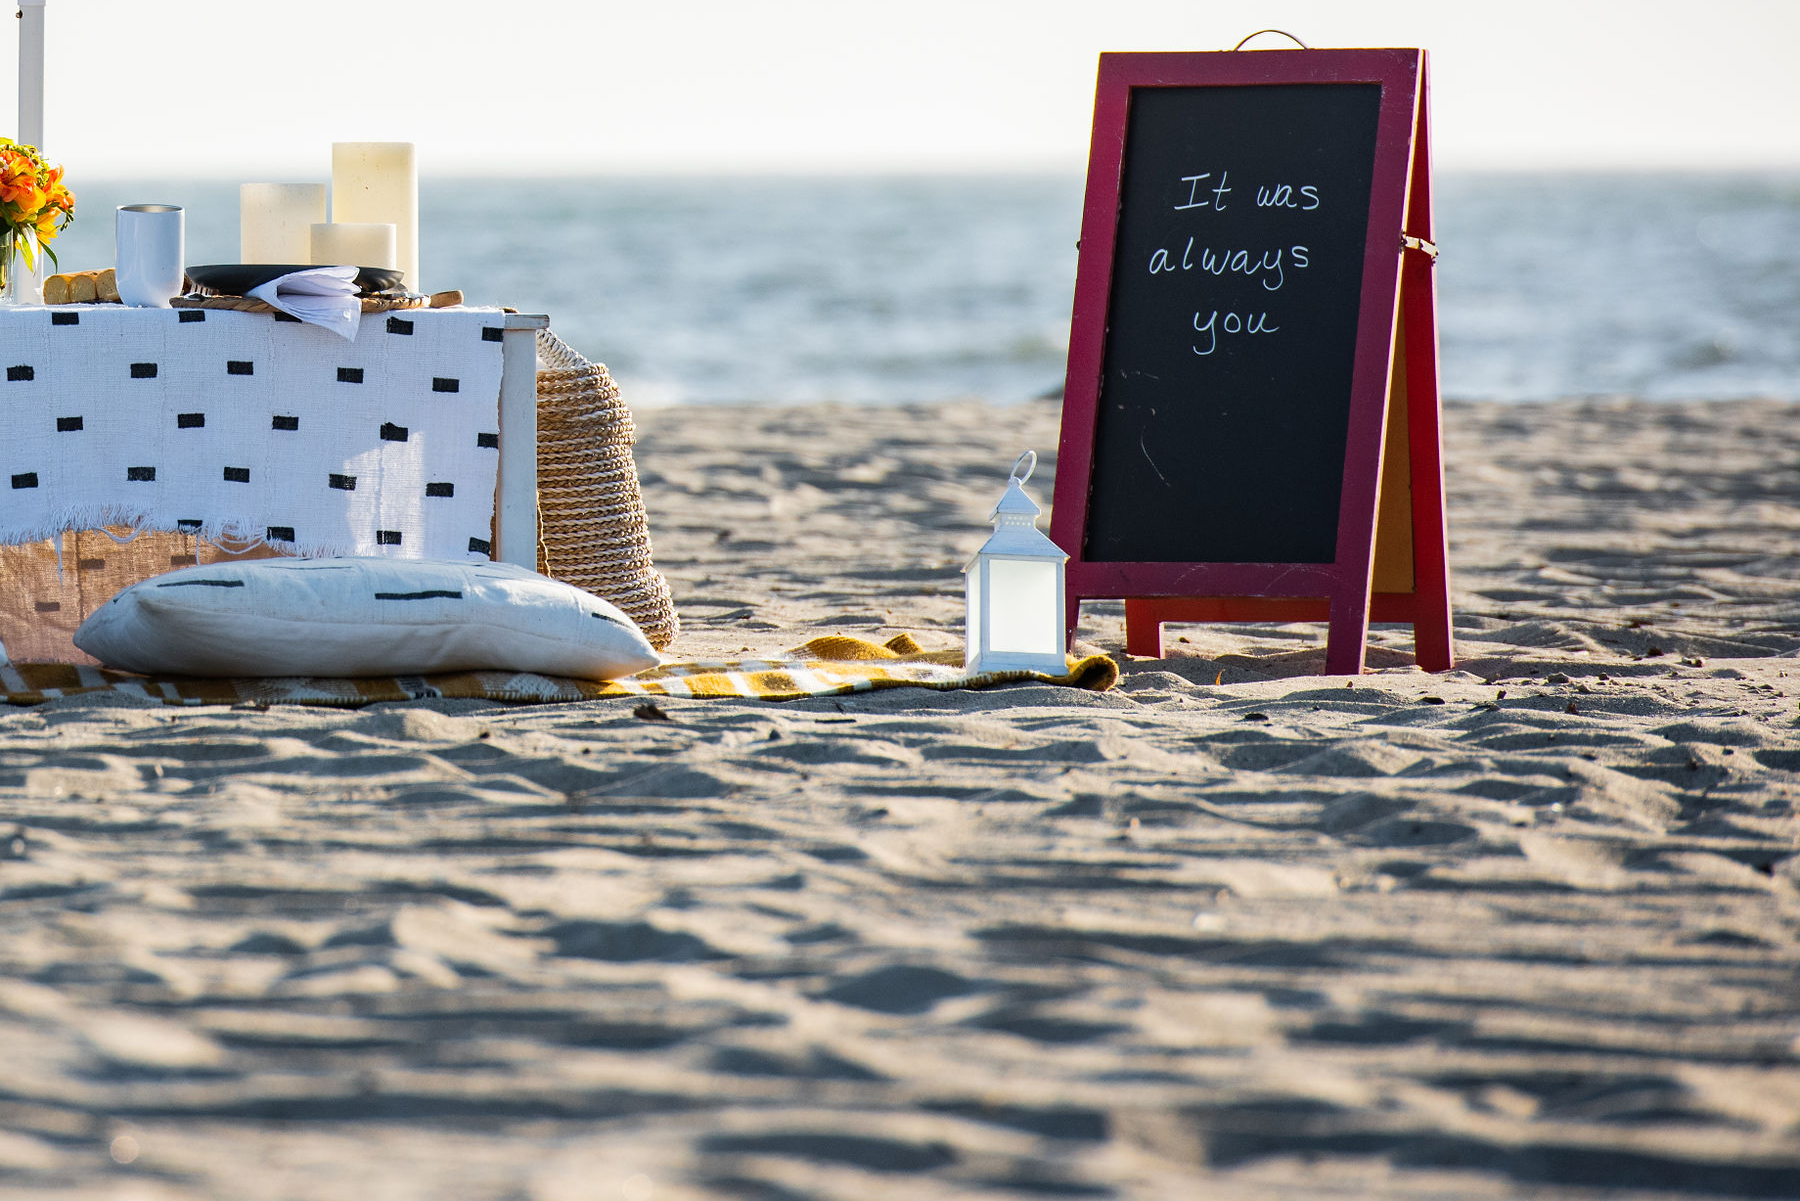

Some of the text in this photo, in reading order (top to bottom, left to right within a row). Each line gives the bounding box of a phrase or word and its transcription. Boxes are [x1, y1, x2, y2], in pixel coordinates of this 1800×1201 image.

[1173, 170, 1320, 212] It was
[1148, 236, 1309, 291] always
[1192, 310, 1280, 356] you
